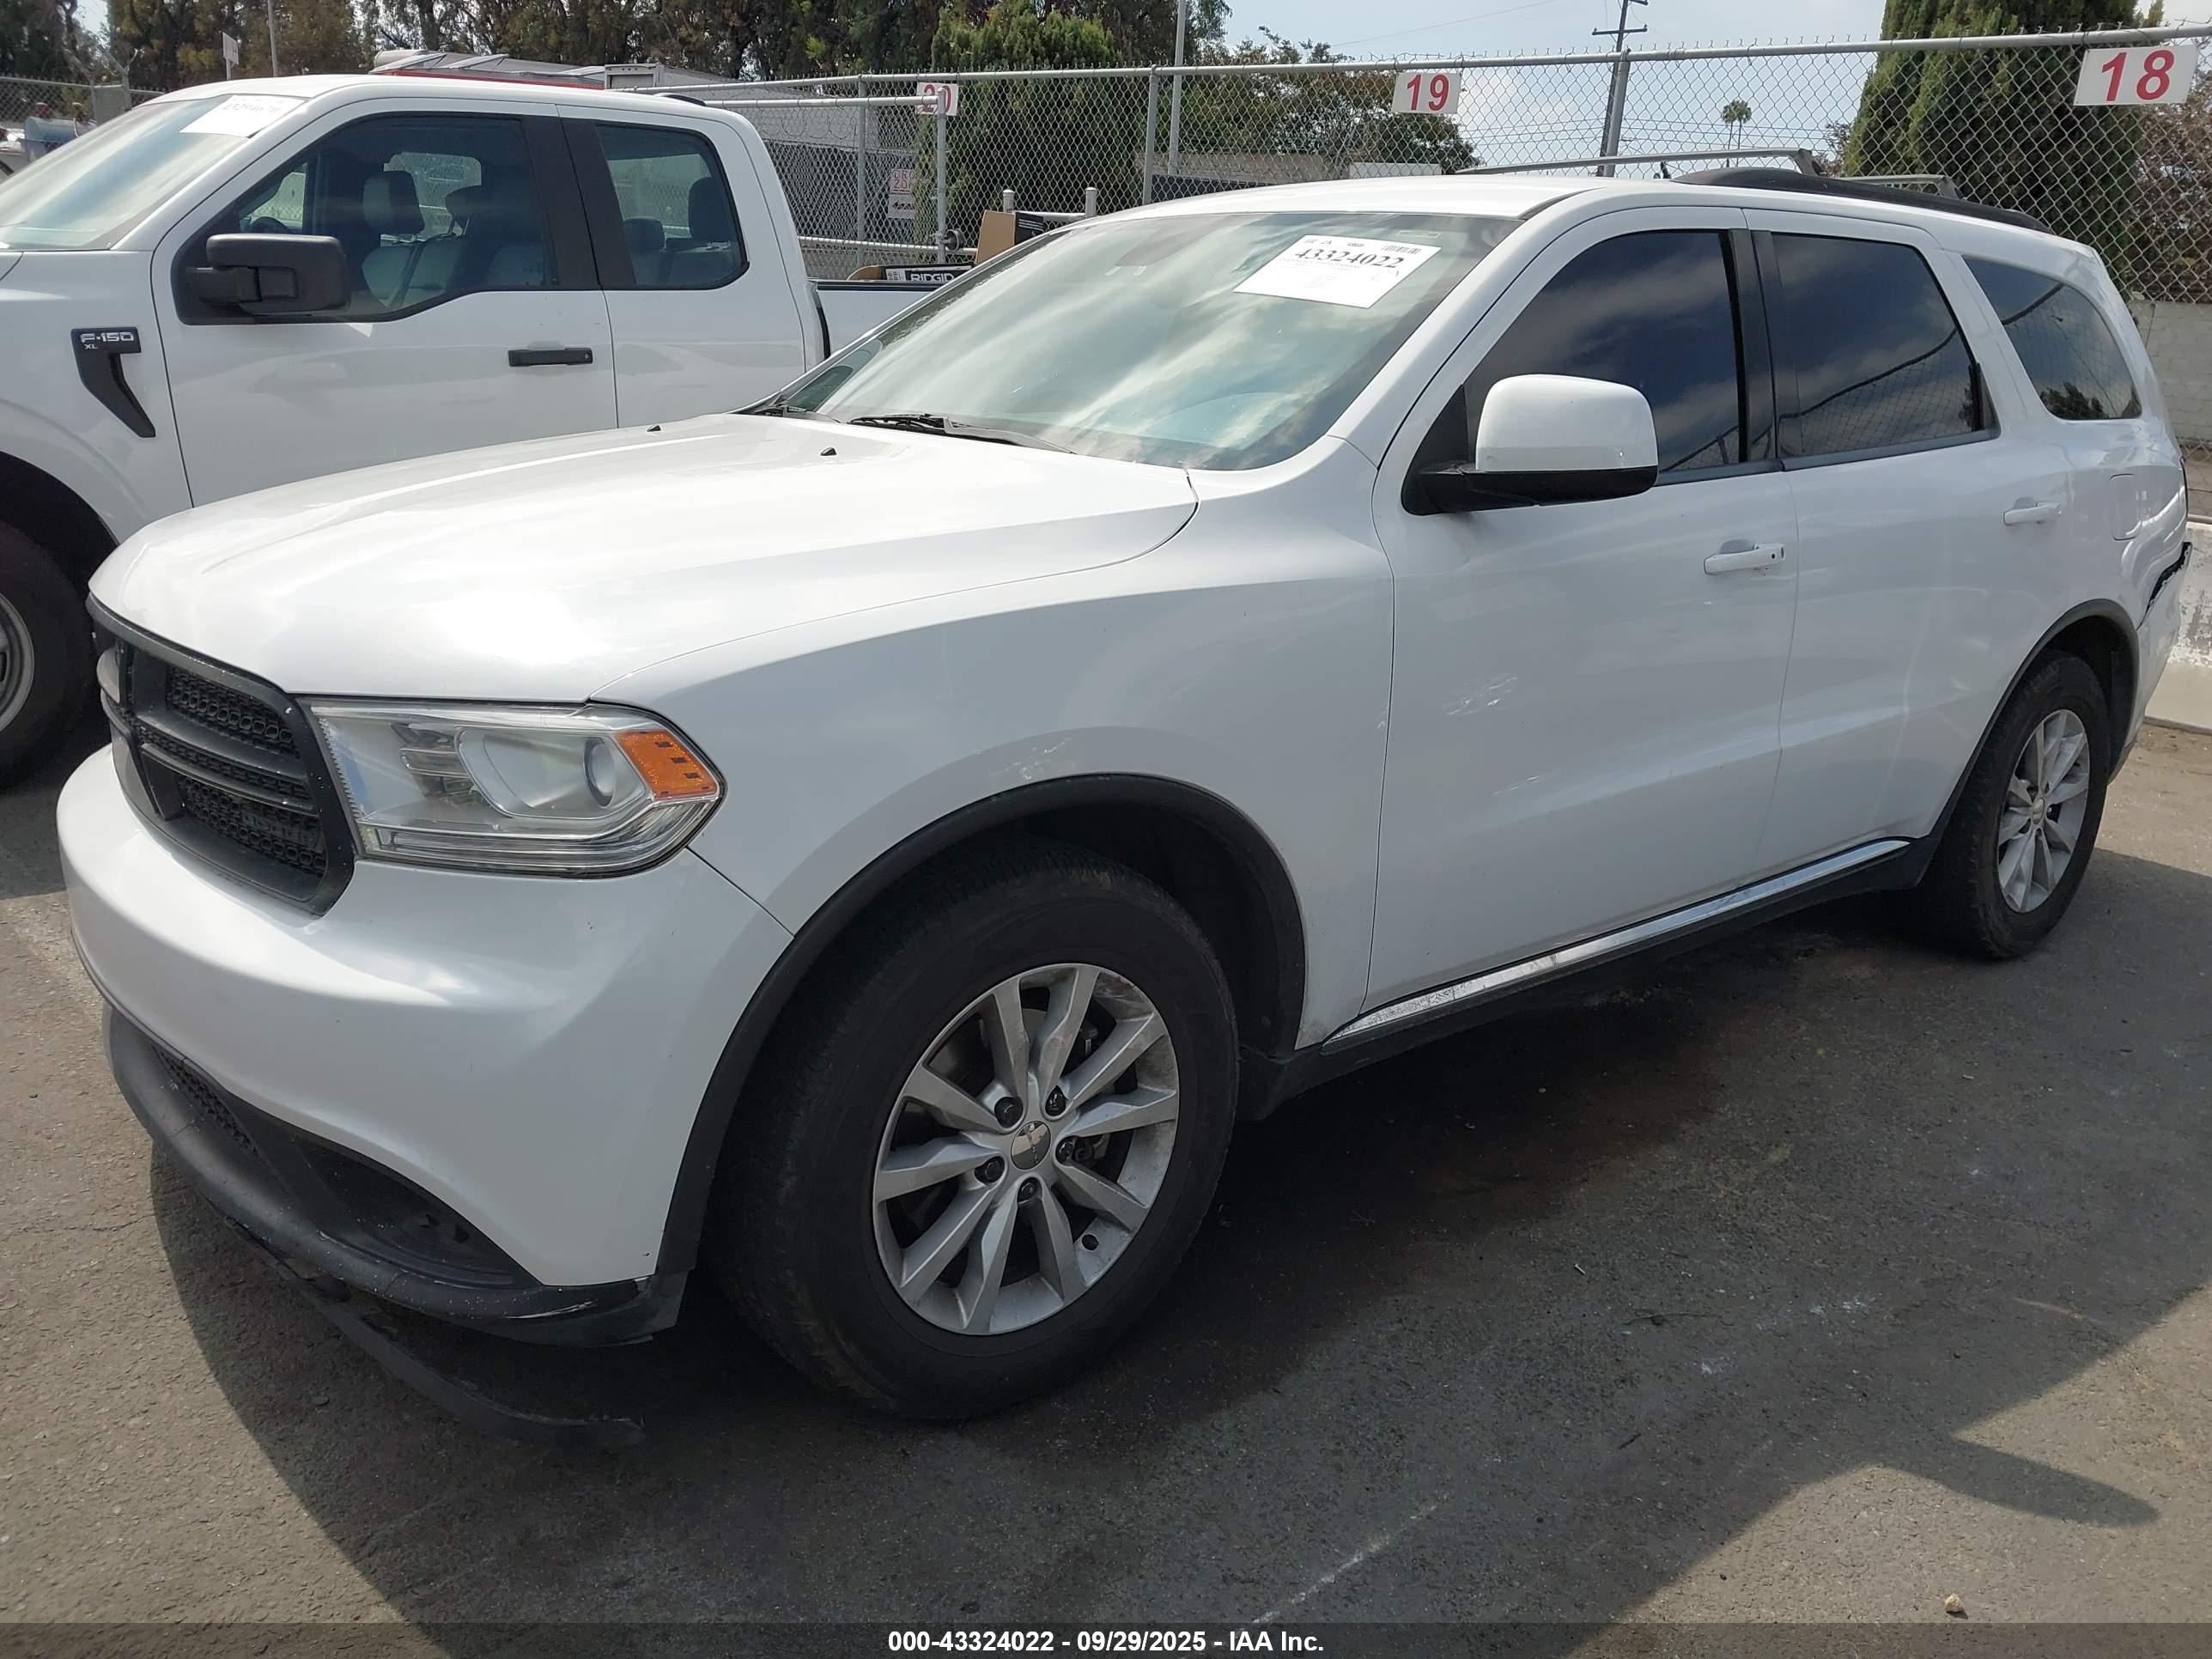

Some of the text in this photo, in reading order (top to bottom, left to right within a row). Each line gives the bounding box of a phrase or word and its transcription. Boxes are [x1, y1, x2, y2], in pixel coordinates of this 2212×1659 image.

[2101, 49, 2175, 102] 18
[1406, 73, 1449, 112] 19
[1294, 248, 1405, 269] 43324022
[910, 272, 955, 283] RIDGID
[79, 331, 134, 343] F-150
